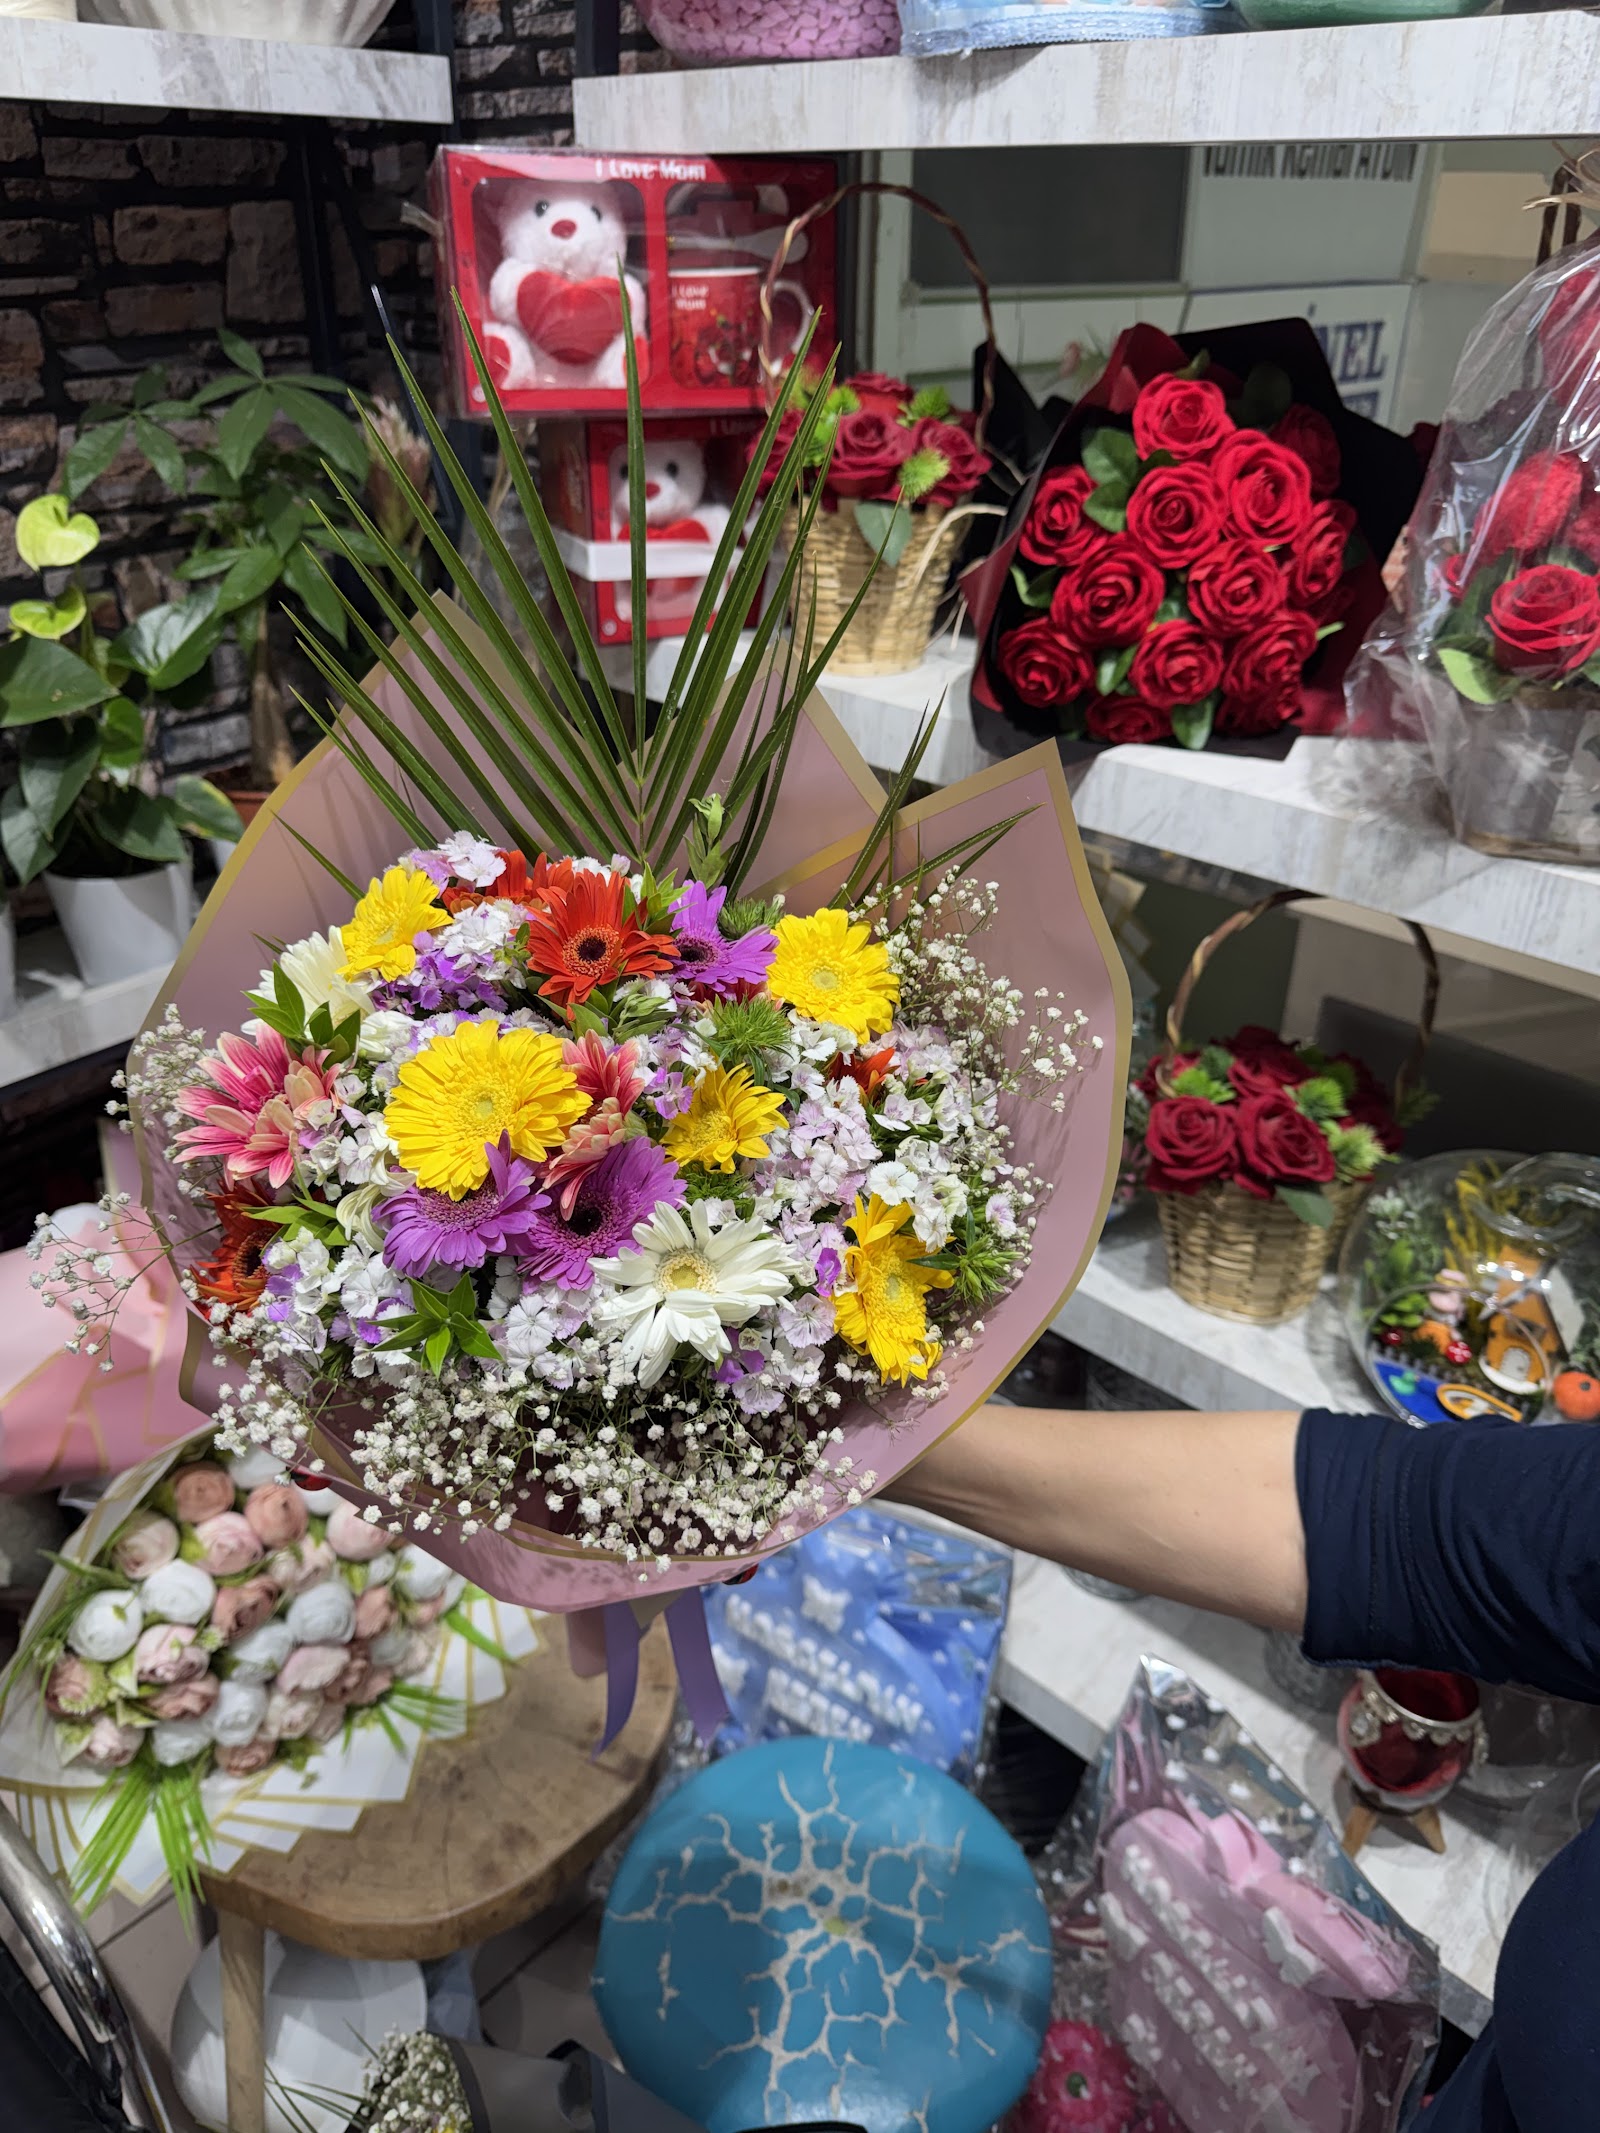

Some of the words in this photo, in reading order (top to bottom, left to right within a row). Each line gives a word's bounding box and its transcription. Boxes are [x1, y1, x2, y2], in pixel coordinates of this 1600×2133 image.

[595, 159, 603, 178] I
[609, 159, 656, 180] Love
[1307, 303, 1387, 383] NEL
